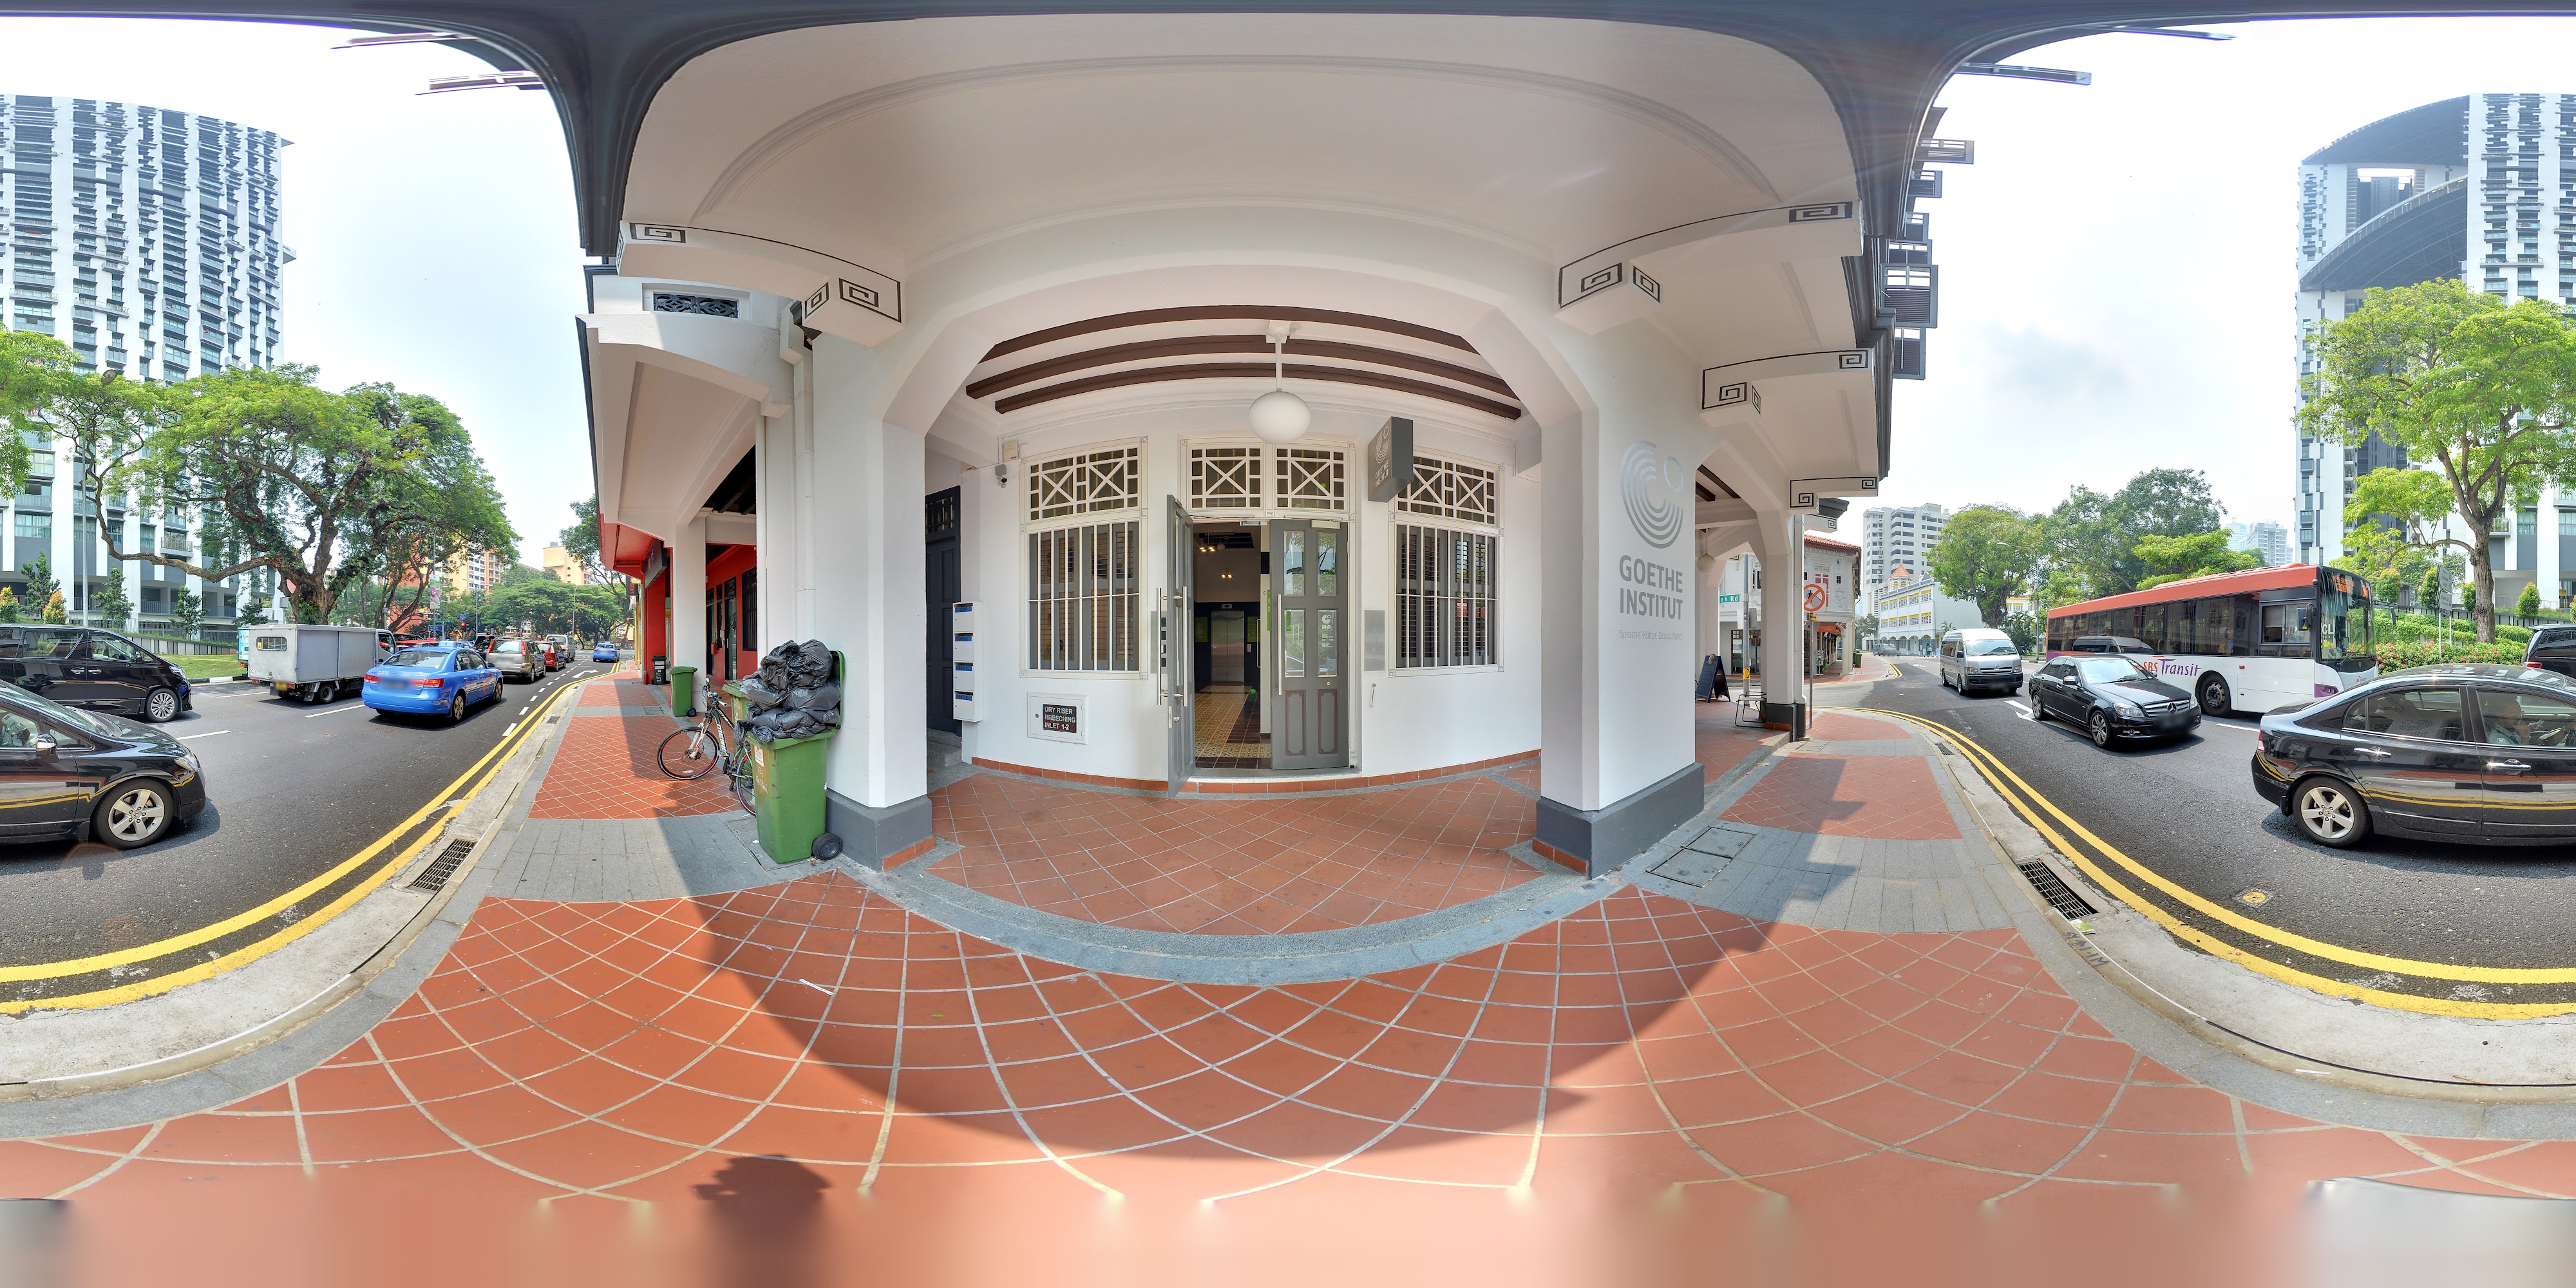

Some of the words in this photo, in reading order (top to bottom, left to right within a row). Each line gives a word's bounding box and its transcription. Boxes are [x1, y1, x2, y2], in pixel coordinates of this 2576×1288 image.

[1375, 459, 1389, 479] GOETHE
[1375, 468, 1389, 488] INSTITUT
[1619, 554, 1683, 594] GOETHE
[1620, 587, 1683, 620] INSTITUT
[1620, 629, 1642, 639] Sprache.
[1643, 630, 1658, 639] Kultur.
[1658, 631, 1683, 640] Deutschland.
[2143, 661, 2158, 672] SBS
[2157, 658, 2202, 676] Transit
[1045, 714, 1076, 723] BREECHING
[716, 723, 726, 753] MERID
